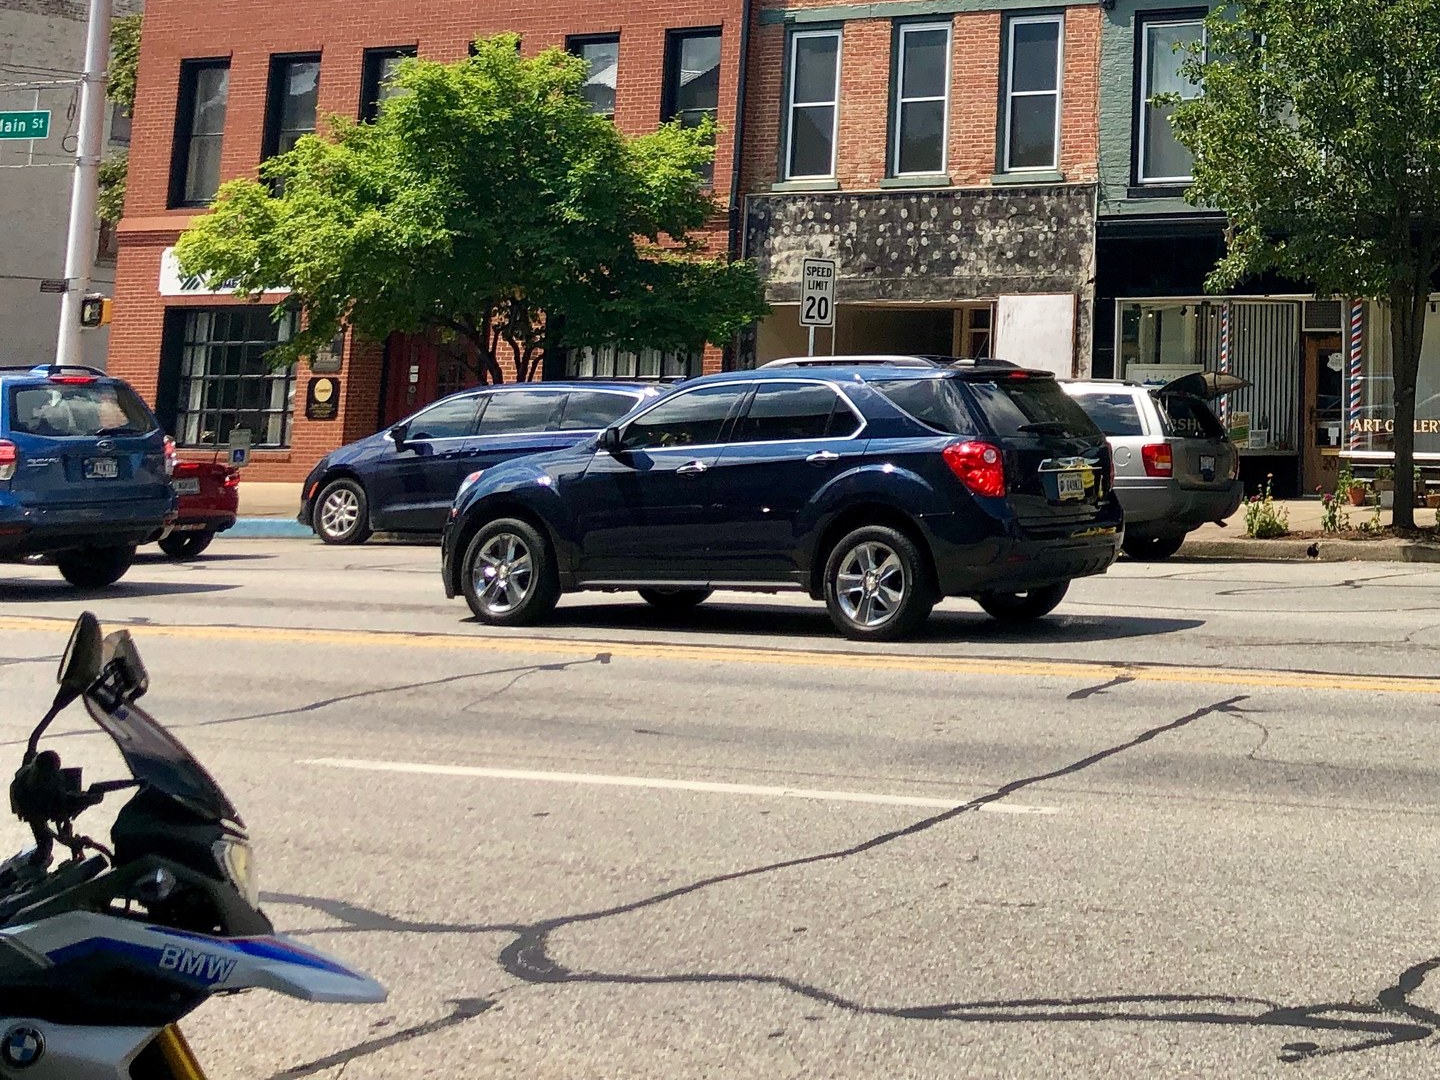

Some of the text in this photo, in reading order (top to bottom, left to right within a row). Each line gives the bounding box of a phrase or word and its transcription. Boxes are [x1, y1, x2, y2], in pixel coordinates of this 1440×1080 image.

[32, 118, 44, 129] St
[806, 266, 832, 277] SPEED
[808, 280, 828, 291] LIMIT
[805, 296, 829, 320] 20
[1352, 419, 1382, 432] ART
[159, 943, 238, 984] BMW
